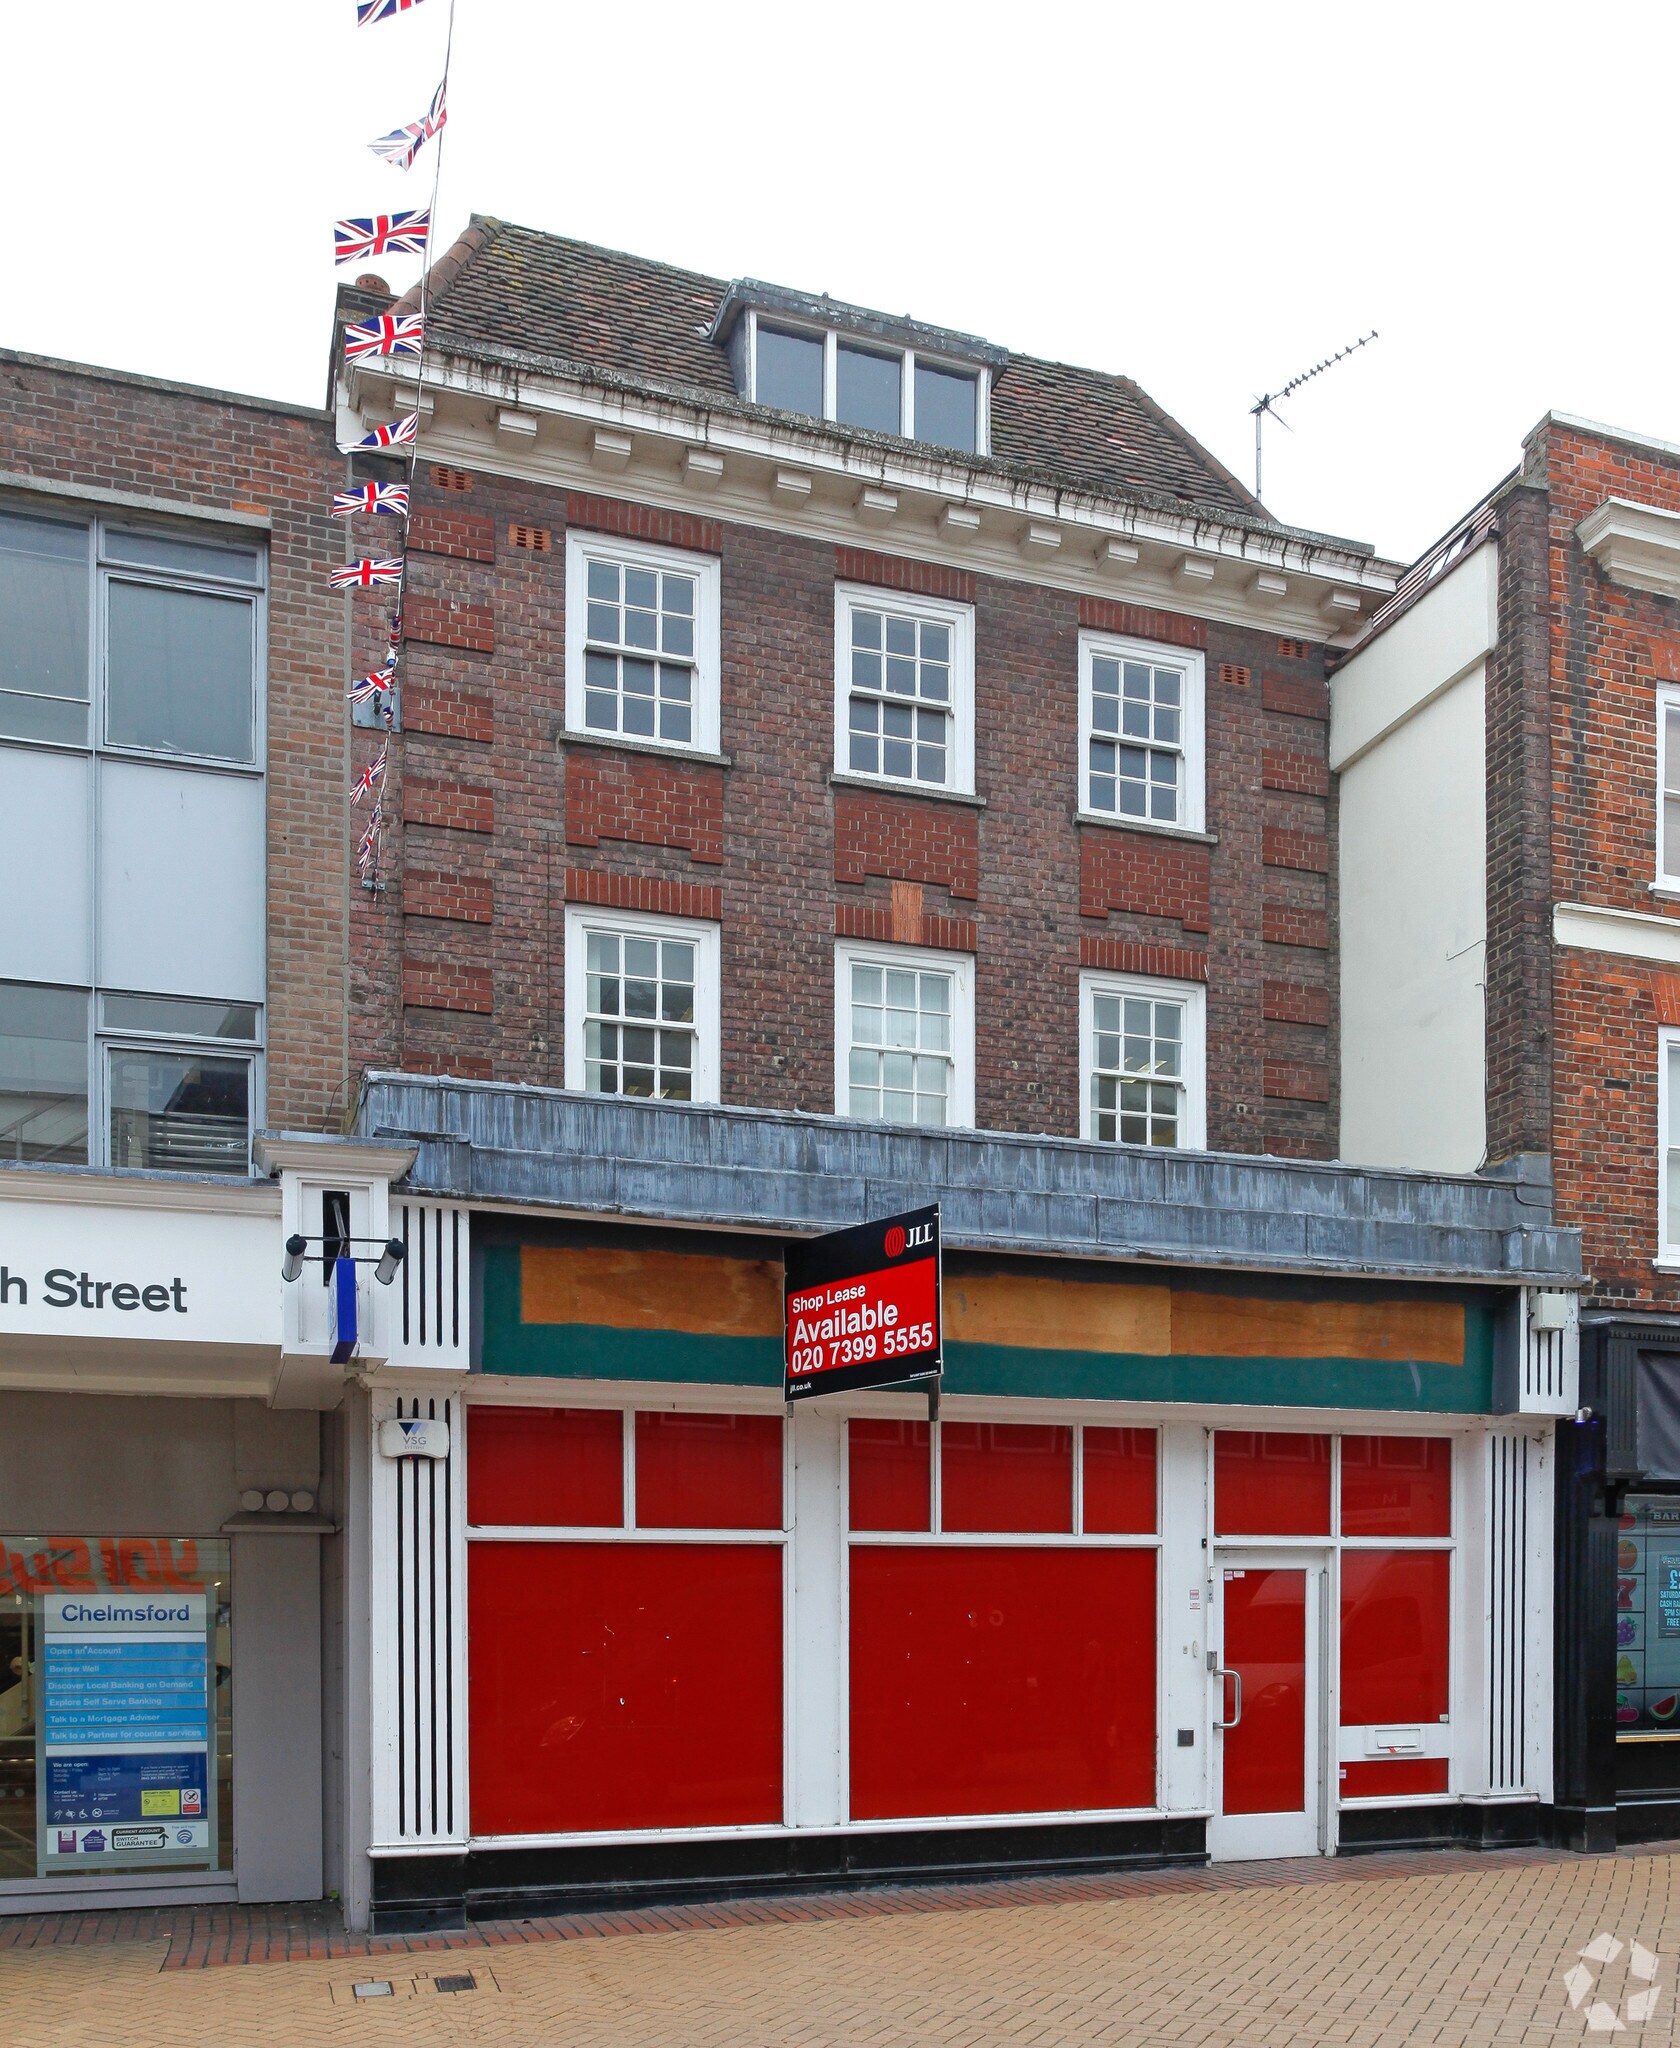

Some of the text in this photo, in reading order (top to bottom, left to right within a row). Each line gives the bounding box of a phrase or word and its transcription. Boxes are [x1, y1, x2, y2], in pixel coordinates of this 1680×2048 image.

[905, 1223, 933, 1249] JLL
[42, 1268, 188, 1313] Street
[792, 1284, 866, 1314] Shop Lease
[792, 1300, 898, 1347] Available
[792, 1322, 933, 1373] 020 7399 5555
[789, 1381, 812, 1394] jll.co.uk
[403, 1436, 427, 1445] VSG
[1660, 1600, 1672, 1608] CASH
[61, 1604, 190, 1622] Chelmsford
[1666, 1618, 1680, 1626] FREE
[50, 1648, 73, 1656] Open
[48, 1682, 84, 1690] Discover
[111, 1681, 144, 1690] Banking
[49, 1699, 81, 1707] Explore
[83, 1698, 100, 1706] Self
[129, 1697, 162, 1706] Banking
[87, 1714, 128, 1724] Mortgage
[87, 1731, 118, 1739] Partner
